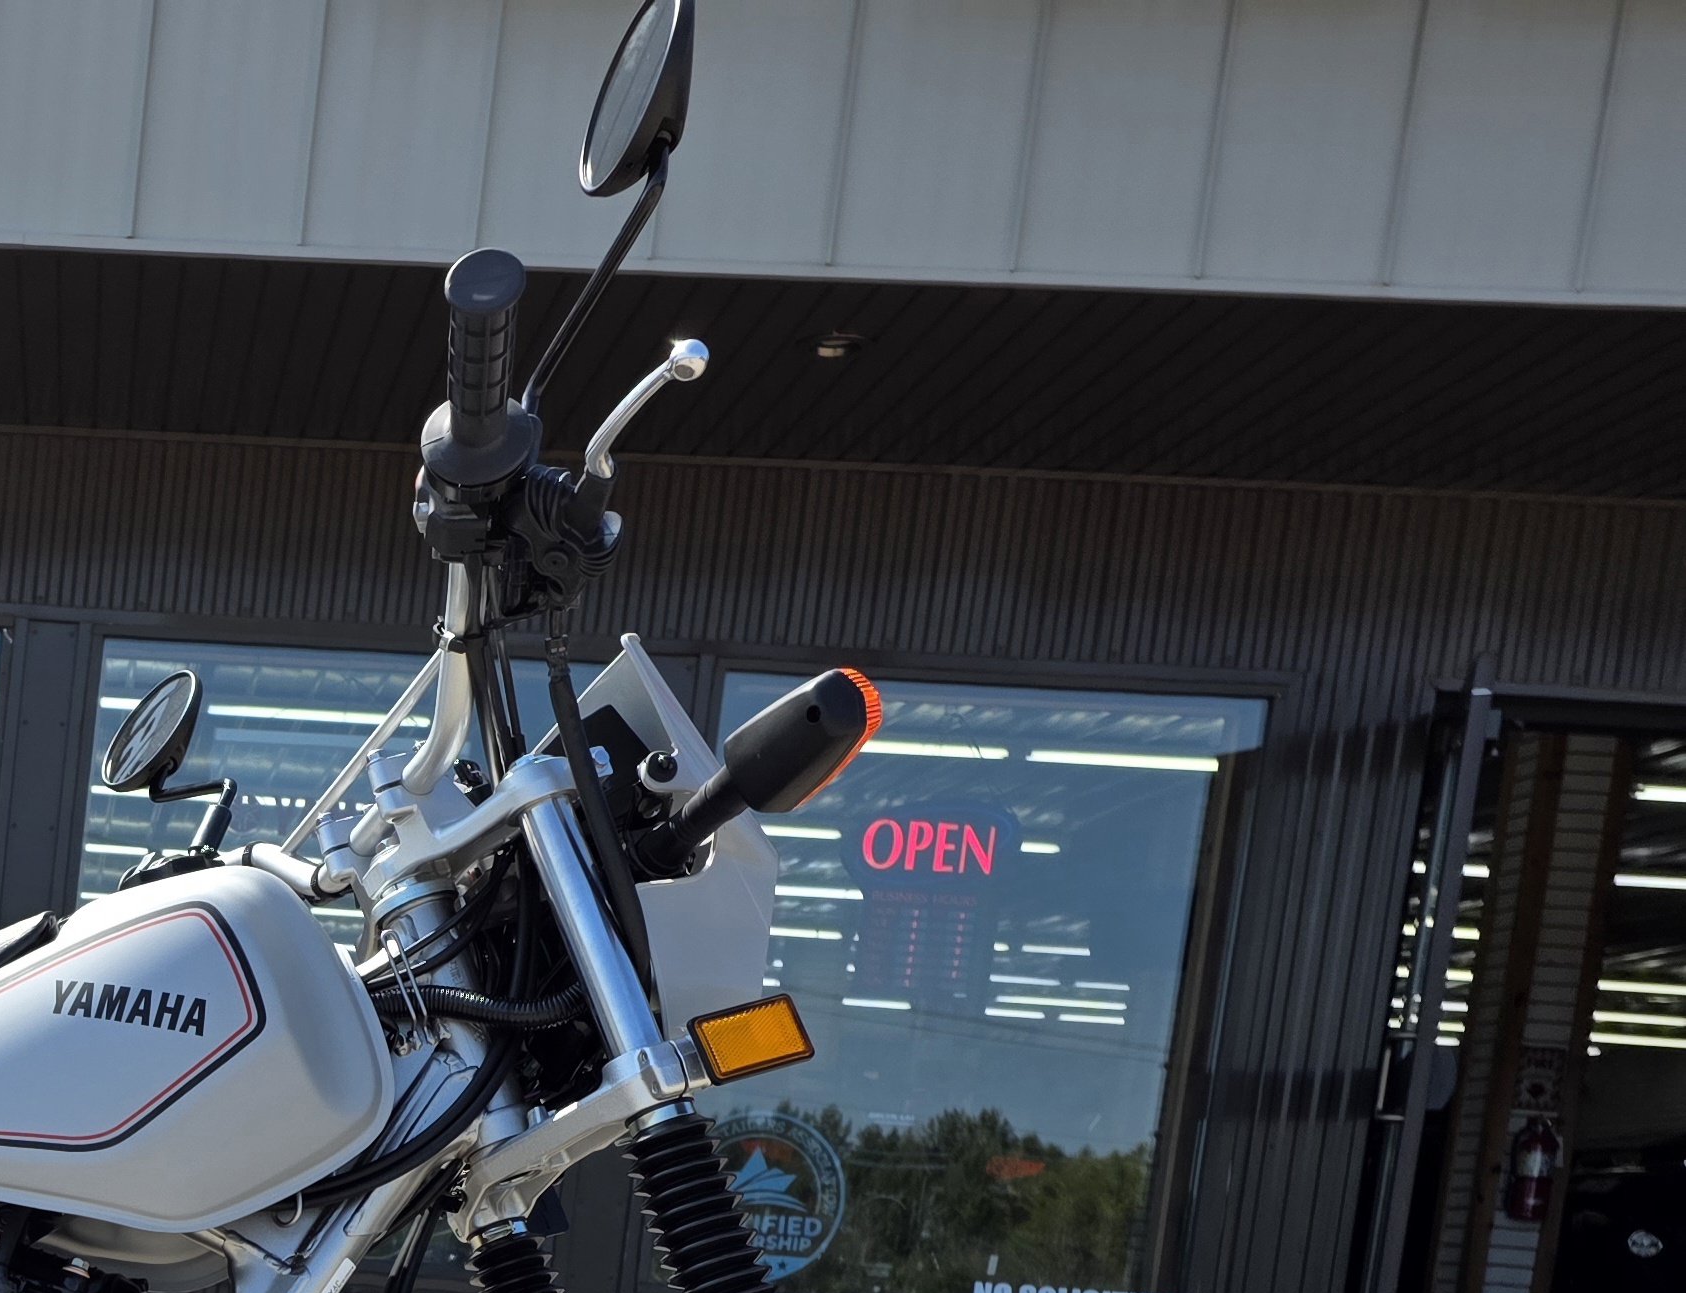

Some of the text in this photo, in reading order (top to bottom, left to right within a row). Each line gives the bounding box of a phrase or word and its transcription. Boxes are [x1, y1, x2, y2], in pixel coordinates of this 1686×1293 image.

[862, 818, 996, 875] OPEN
[53, 980, 206, 1037] YAMAHA
[722, 1117, 786, 1137] TAILERS
[753, 1214, 822, 1238] IFIED
[754, 1235, 812, 1252] RSHIP
